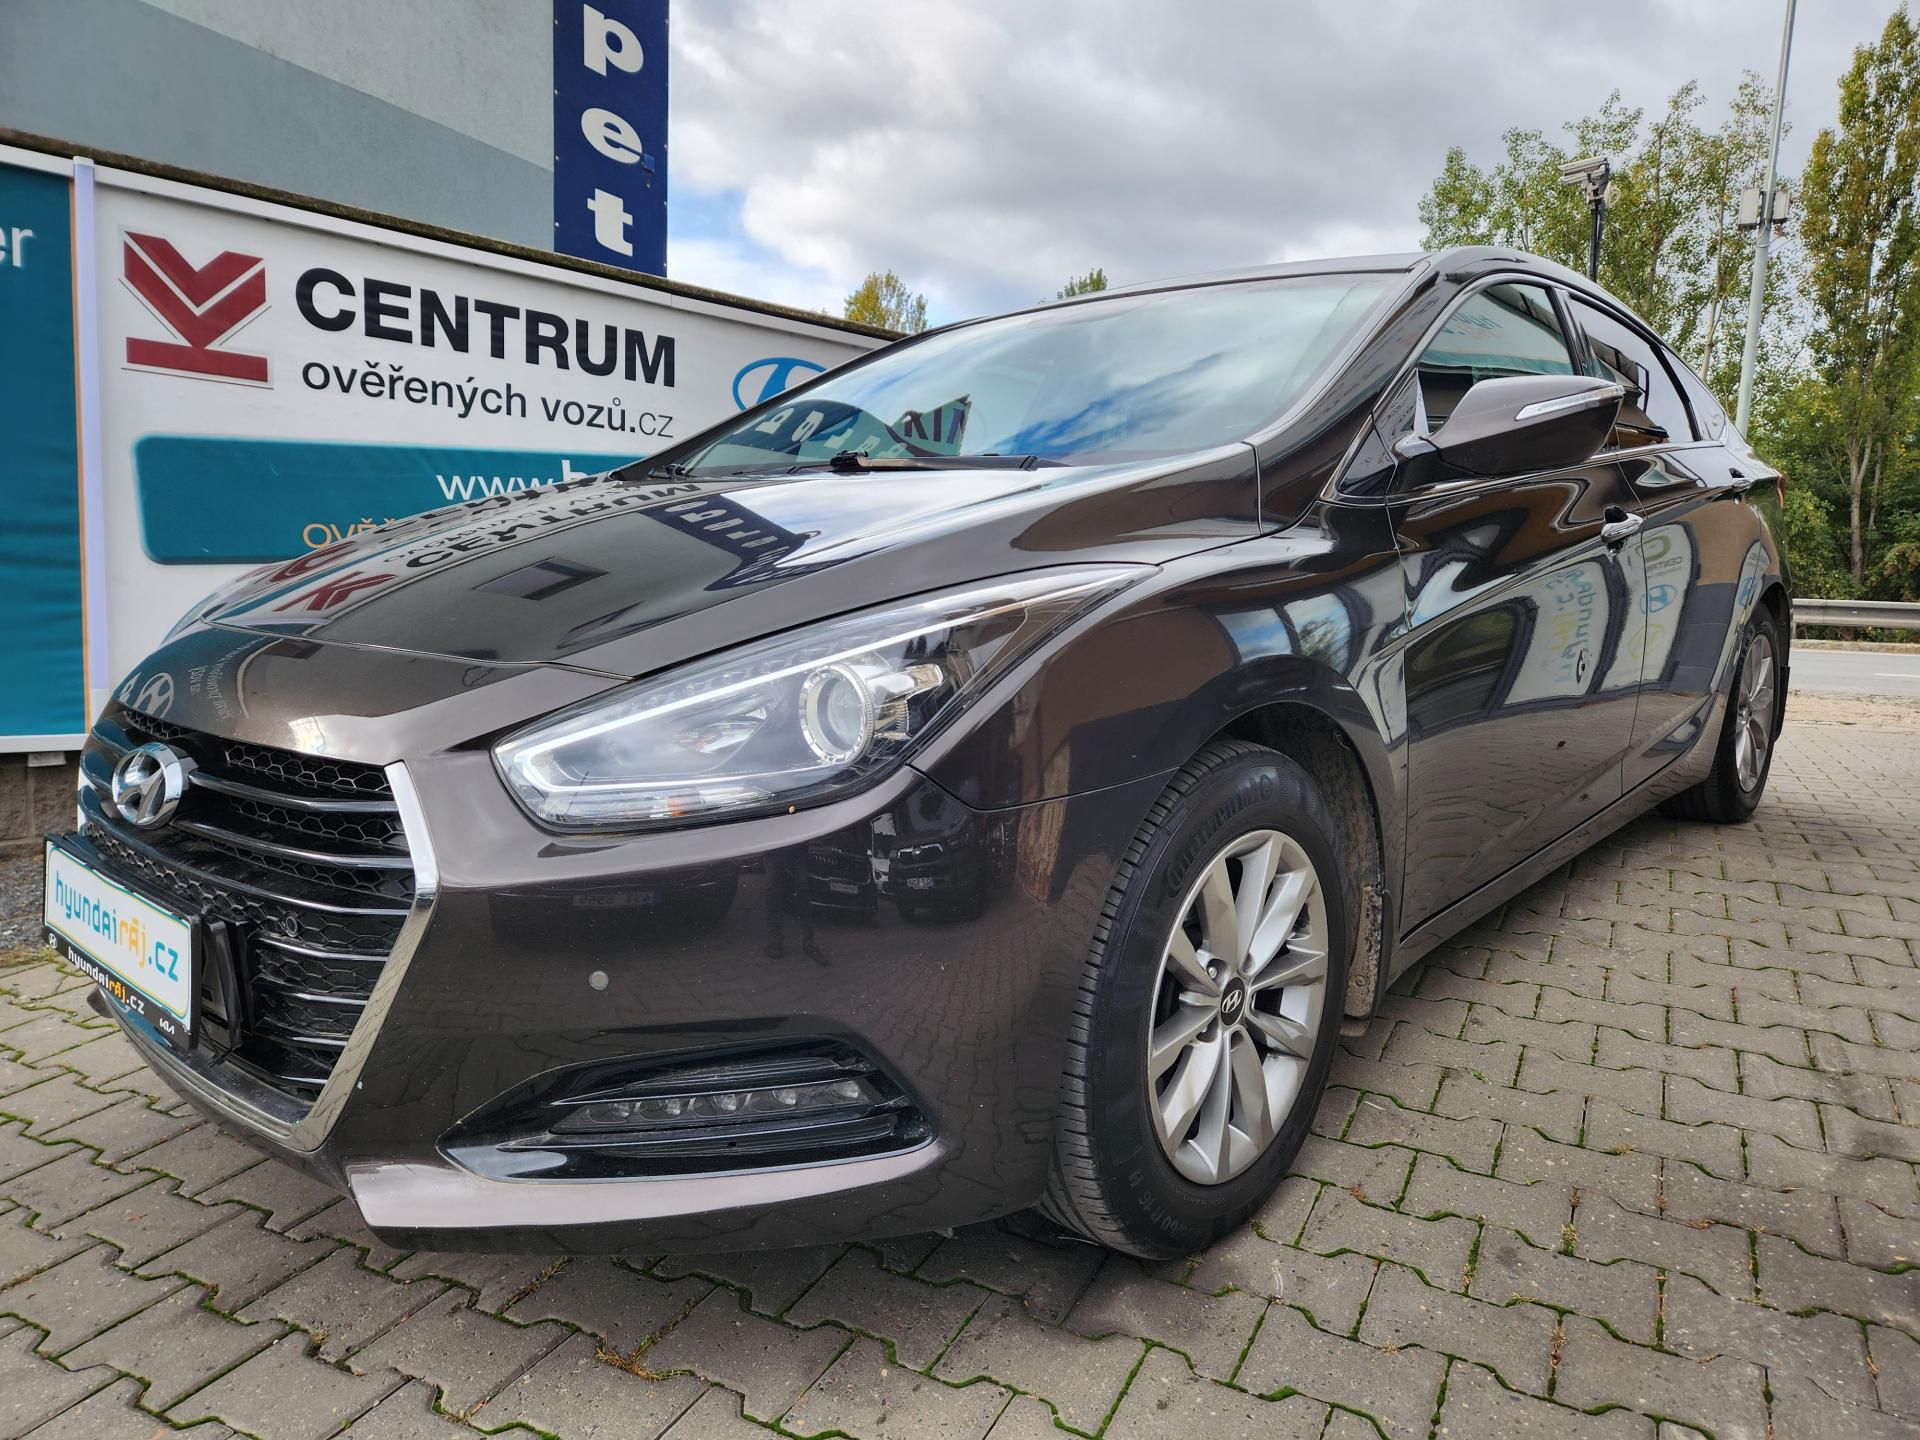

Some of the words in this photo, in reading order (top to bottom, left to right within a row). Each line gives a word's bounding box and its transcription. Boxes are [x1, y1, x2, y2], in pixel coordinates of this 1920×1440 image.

[0, 227, 33, 268] r
[295, 267, 675, 388] CENTRUM
[302, 360, 527, 419] ověřených
[541, 397, 674, 438] vozů.cz
